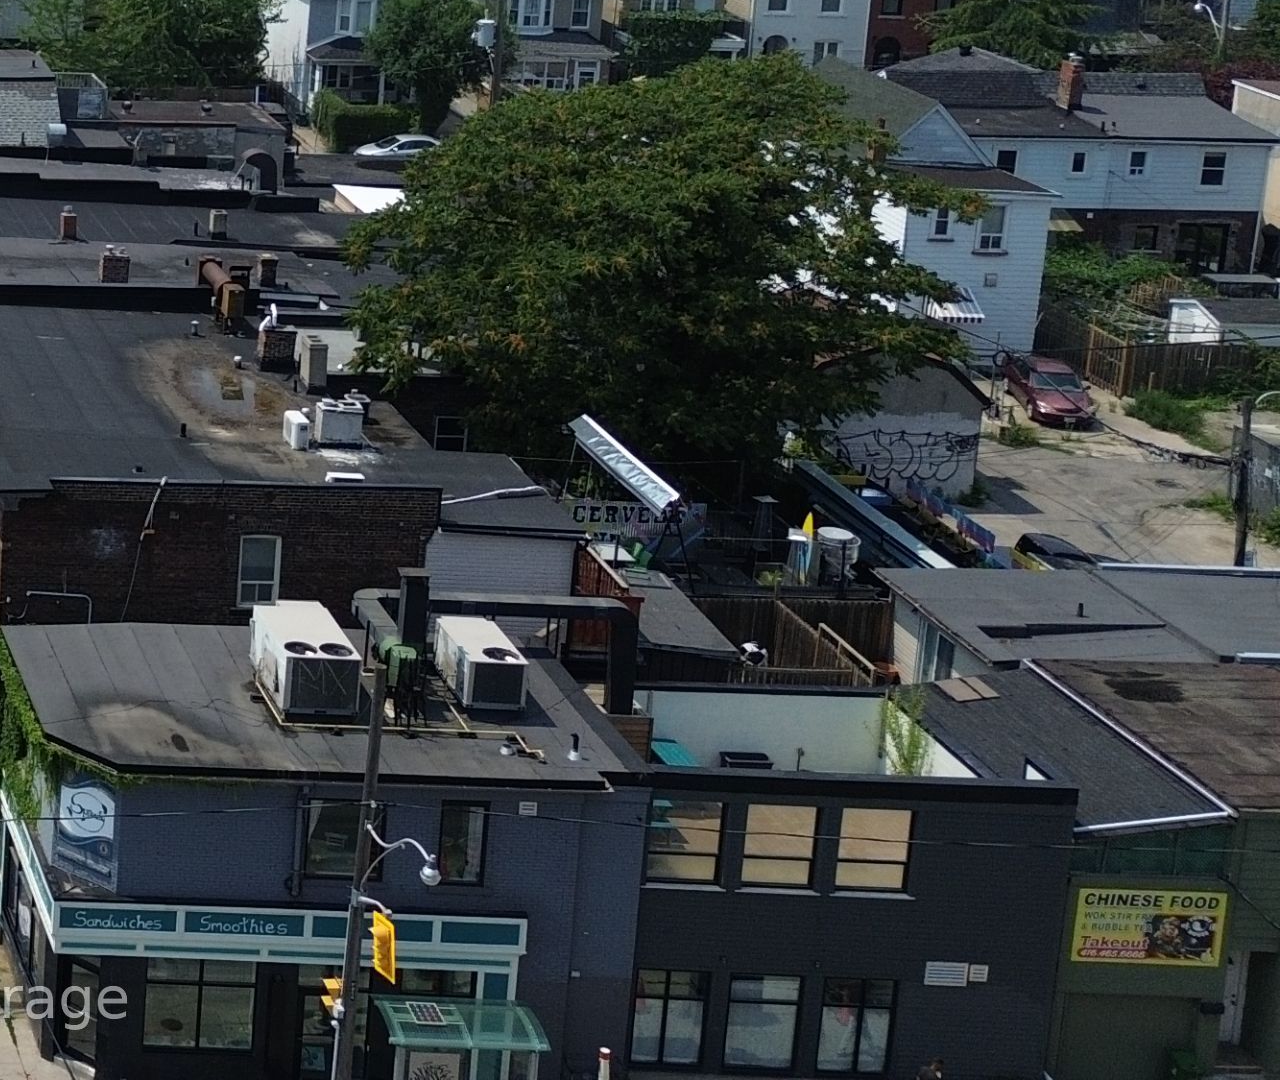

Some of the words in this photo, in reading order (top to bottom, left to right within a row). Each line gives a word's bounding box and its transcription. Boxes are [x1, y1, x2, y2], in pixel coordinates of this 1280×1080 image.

[1084, 893, 1165, 907] CHINESE
[1170, 896, 1221, 909] FOOD
[74, 910, 162, 931] Sandwiches
[1084, 911, 1107, 920] WOK
[1110, 912, 1132, 920] STIR
[199, 914, 288, 936] Smoothies
[1091, 923, 1129, 931] BUBBLE
[1081, 935, 1151, 949] Takeout
